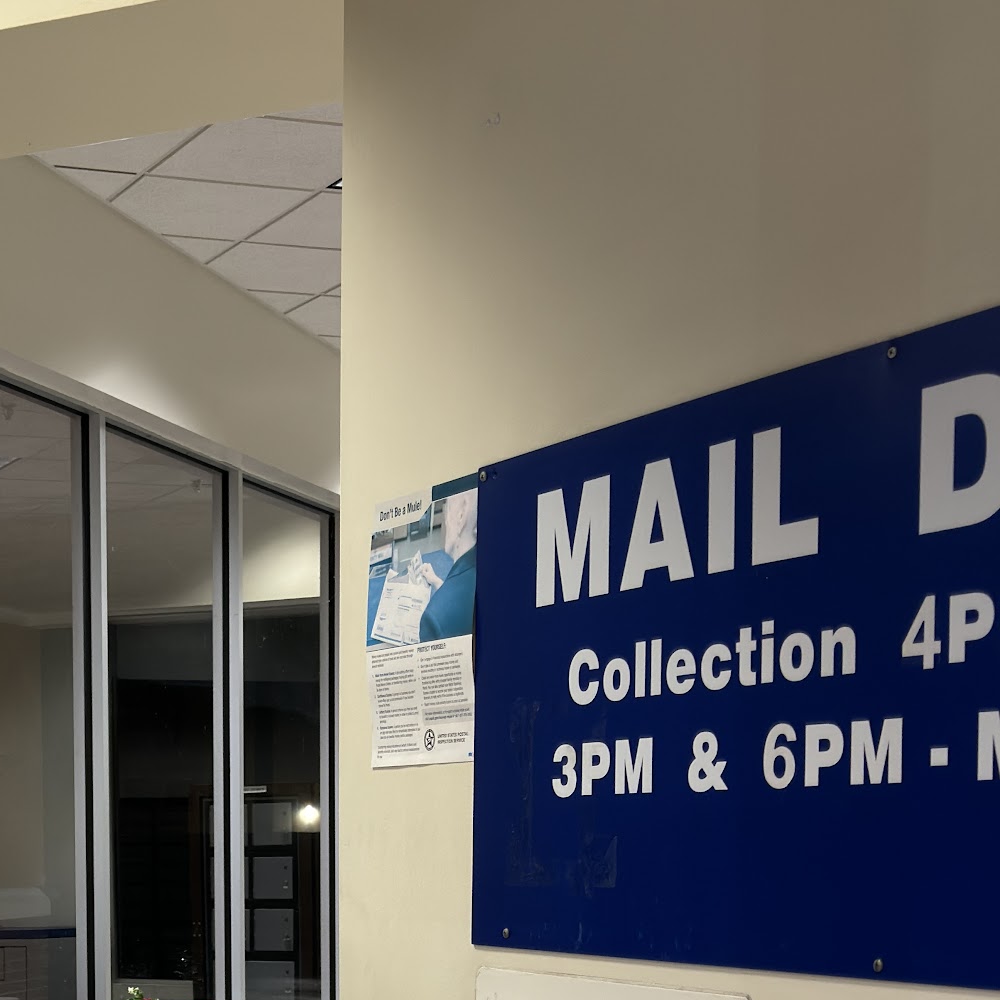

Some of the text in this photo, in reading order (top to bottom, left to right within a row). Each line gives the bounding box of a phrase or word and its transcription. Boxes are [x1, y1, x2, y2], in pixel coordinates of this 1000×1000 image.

[379, 500, 422, 521] Don't Be a Mule!
[536, 427, 819, 608] MAIL
[568, 592, 995, 706] Collection 4P
[551, 737, 654, 798] 3PM
[687, 731, 729, 792] &
[762, 718, 904, 790] 6PM
